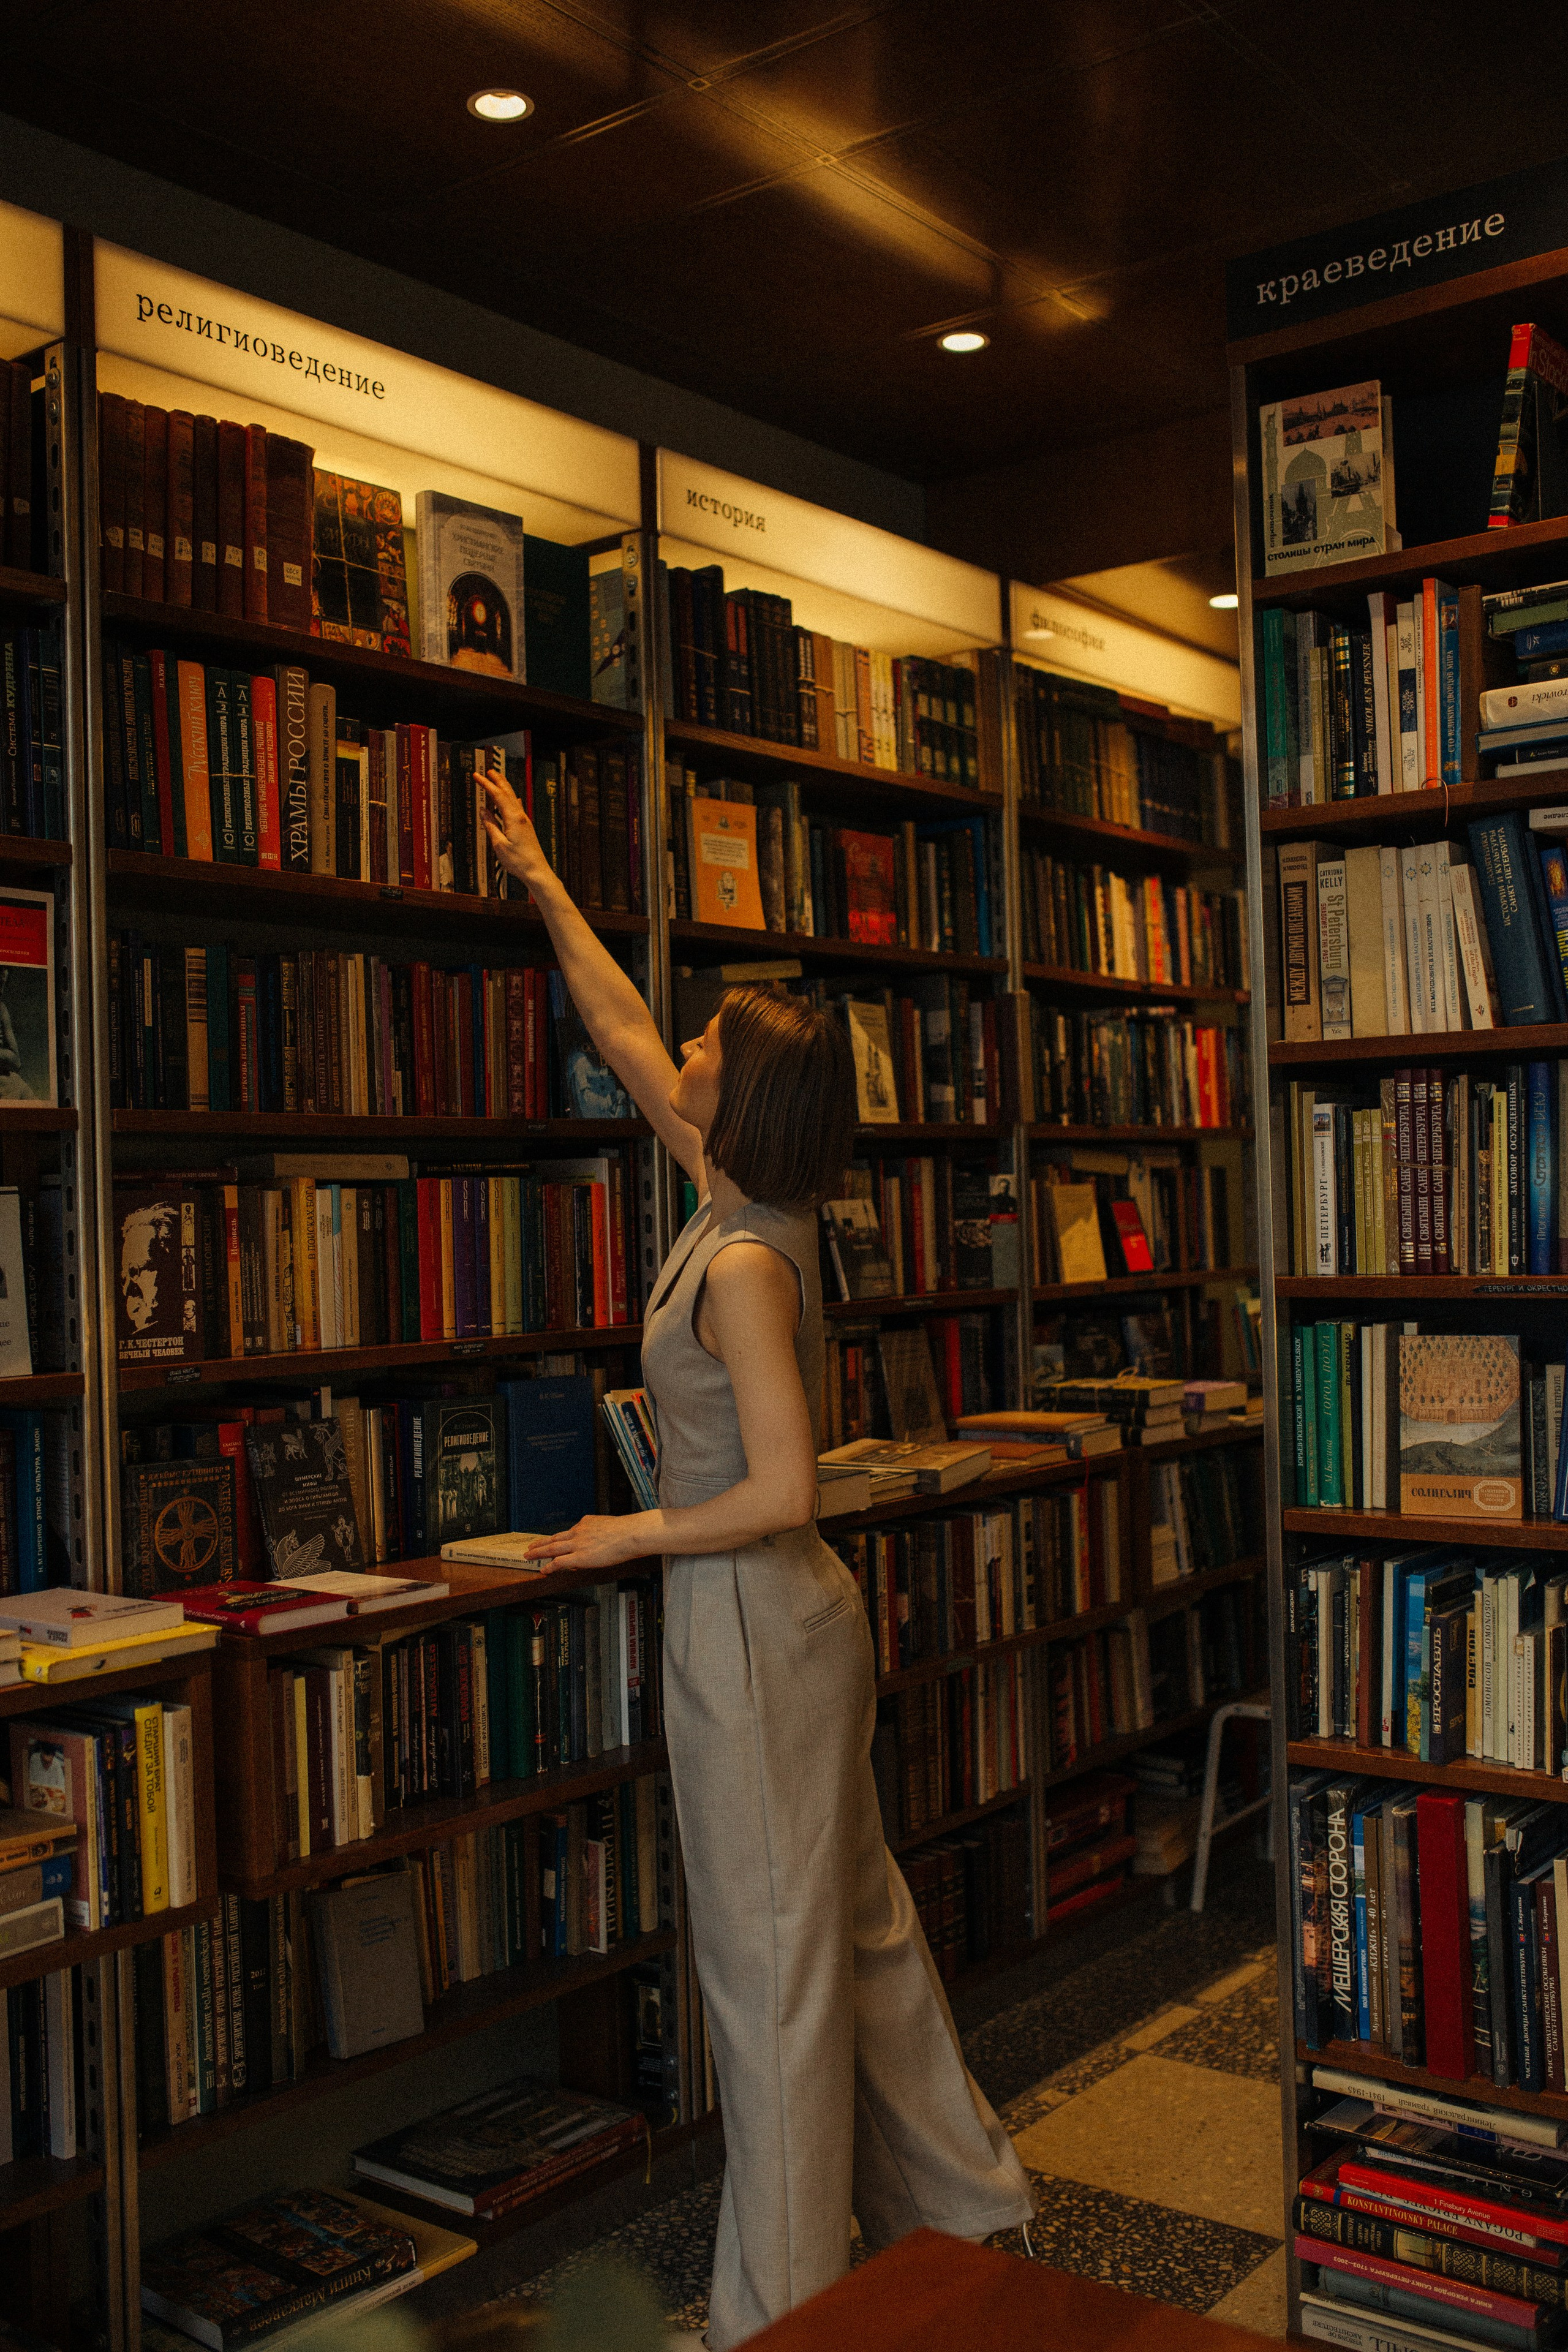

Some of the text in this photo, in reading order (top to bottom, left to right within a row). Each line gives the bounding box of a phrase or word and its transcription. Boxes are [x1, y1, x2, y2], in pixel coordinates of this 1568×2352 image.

[1256, 212, 1506, 305] краеведение
[137, 293, 386, 401] религиоведение
[687, 489, 766, 532] история
[1267, 537, 1376, 562] столицы стран мира
[1362, 643, 1374, 734] NIKOLAUS PEVSNER
[219, 715, 228, 736] МИРА
[255, 720, 268, 833] ДАНИЛЫ ТЕРЕНТЬЕВИЧА ЗАЙЦЕВА
[286, 669, 309, 864] ХРАМЫ РОССИИ
[1319, 868, 1343, 877] CATRIONA
[1480, 831, 1496, 886] ПАМЯТНИКИ
[1488, 829, 1503, 875] КУЛЬТУРЫ
[1498, 827, 1518, 913] САНКТ-ПЕТЕРБУРГА
[1319, 876, 1343, 889] KELLY
[1287, 886, 1303, 933] ОКЕАНАМИ
[1498, 885, 1512, 927] ИСТОРИИ
[1288, 935, 1305, 966] ДВУМЯ
[1325, 894, 1346, 970] St Petersburg
[1289, 967, 1306, 1001] МЕЖДУ
[1415, 1106, 1430, 1241] СВЯТЫНИ САНК-ПЕТЕРБУРГА
[306, 1185, 315, 1208] БОГА
[1319, 1178, 1329, 1239] ПЕТЕРБУРГ
[1400, 1195, 1412, 1239] СВЯТЫНИ
[1433, 1195, 1445, 1240] СВЯТЫНИ
[230, 1218, 239, 1256] Исповедь
[307, 1209, 316, 1251] ПОИСКАХ
[118, 1347, 184, 1360] ВЕЧНЫЙ ЧЕЛОВЕК
[1322, 1335, 1331, 1374] ПОЭТА
[1323, 1379, 1332, 1416] ГОРОД
[345, 1408, 355, 1461] ЖИЗНЬ
[413, 1416, 423, 1479] РЕЛИГИОВЕДЕНИЕ
[443, 1431, 489, 1448] РЕЛИГИОВЕДЕНИЕ
[221, 1473, 232, 1512] PATHS
[294, 1473, 322, 1482] ШУМЕРСКИЕ
[1411, 1487, 1472, 1499] СОЛИГАЛИЧ
[222, 1515, 233, 1531] OF
[1432, 1627, 1442, 1724] ЯРОСЛАВЛЬ
[1468, 1629, 1476, 1689] РОСТОВ
[152, 1716, 160, 1767] СТАРШИЙ
[144, 1717, 156, 1813] СЛЕДИТ ЗА ТОБОЙ
[1327, 1807, 1352, 2013] МЕЩЕРСКАЯ СТОРОНА
[1368, 1908, 1376, 1920] 40
[1369, 1929, 1379, 1972] «КИЖИ»
[1543, 1992, 1554, 2079] АРИСТОКРАТИЧЕСКИЕ
[1549, 1977, 1558, 2051] САНКТ-ПЕТЕРБУРГА
[1347, 2086, 1497, 2130] Ленинградский трамвай 1941-1945
[1347, 2196, 1458, 2236] KONSTANTINOVSKY PALACE
[1439, 2199, 1466, 2214] Finsbury
[1467, 2207, 1491, 2220] Avenue
[248, 2265, 372, 2333] Книги Маккавеев
[1369, 2266, 1433, 2291] САНКТ-ПЕТЕРБУРГА
[1433, 2286, 1469, 2302] РЕКОРДОВ
[1469, 2296, 1493, 2309] КНИГА
